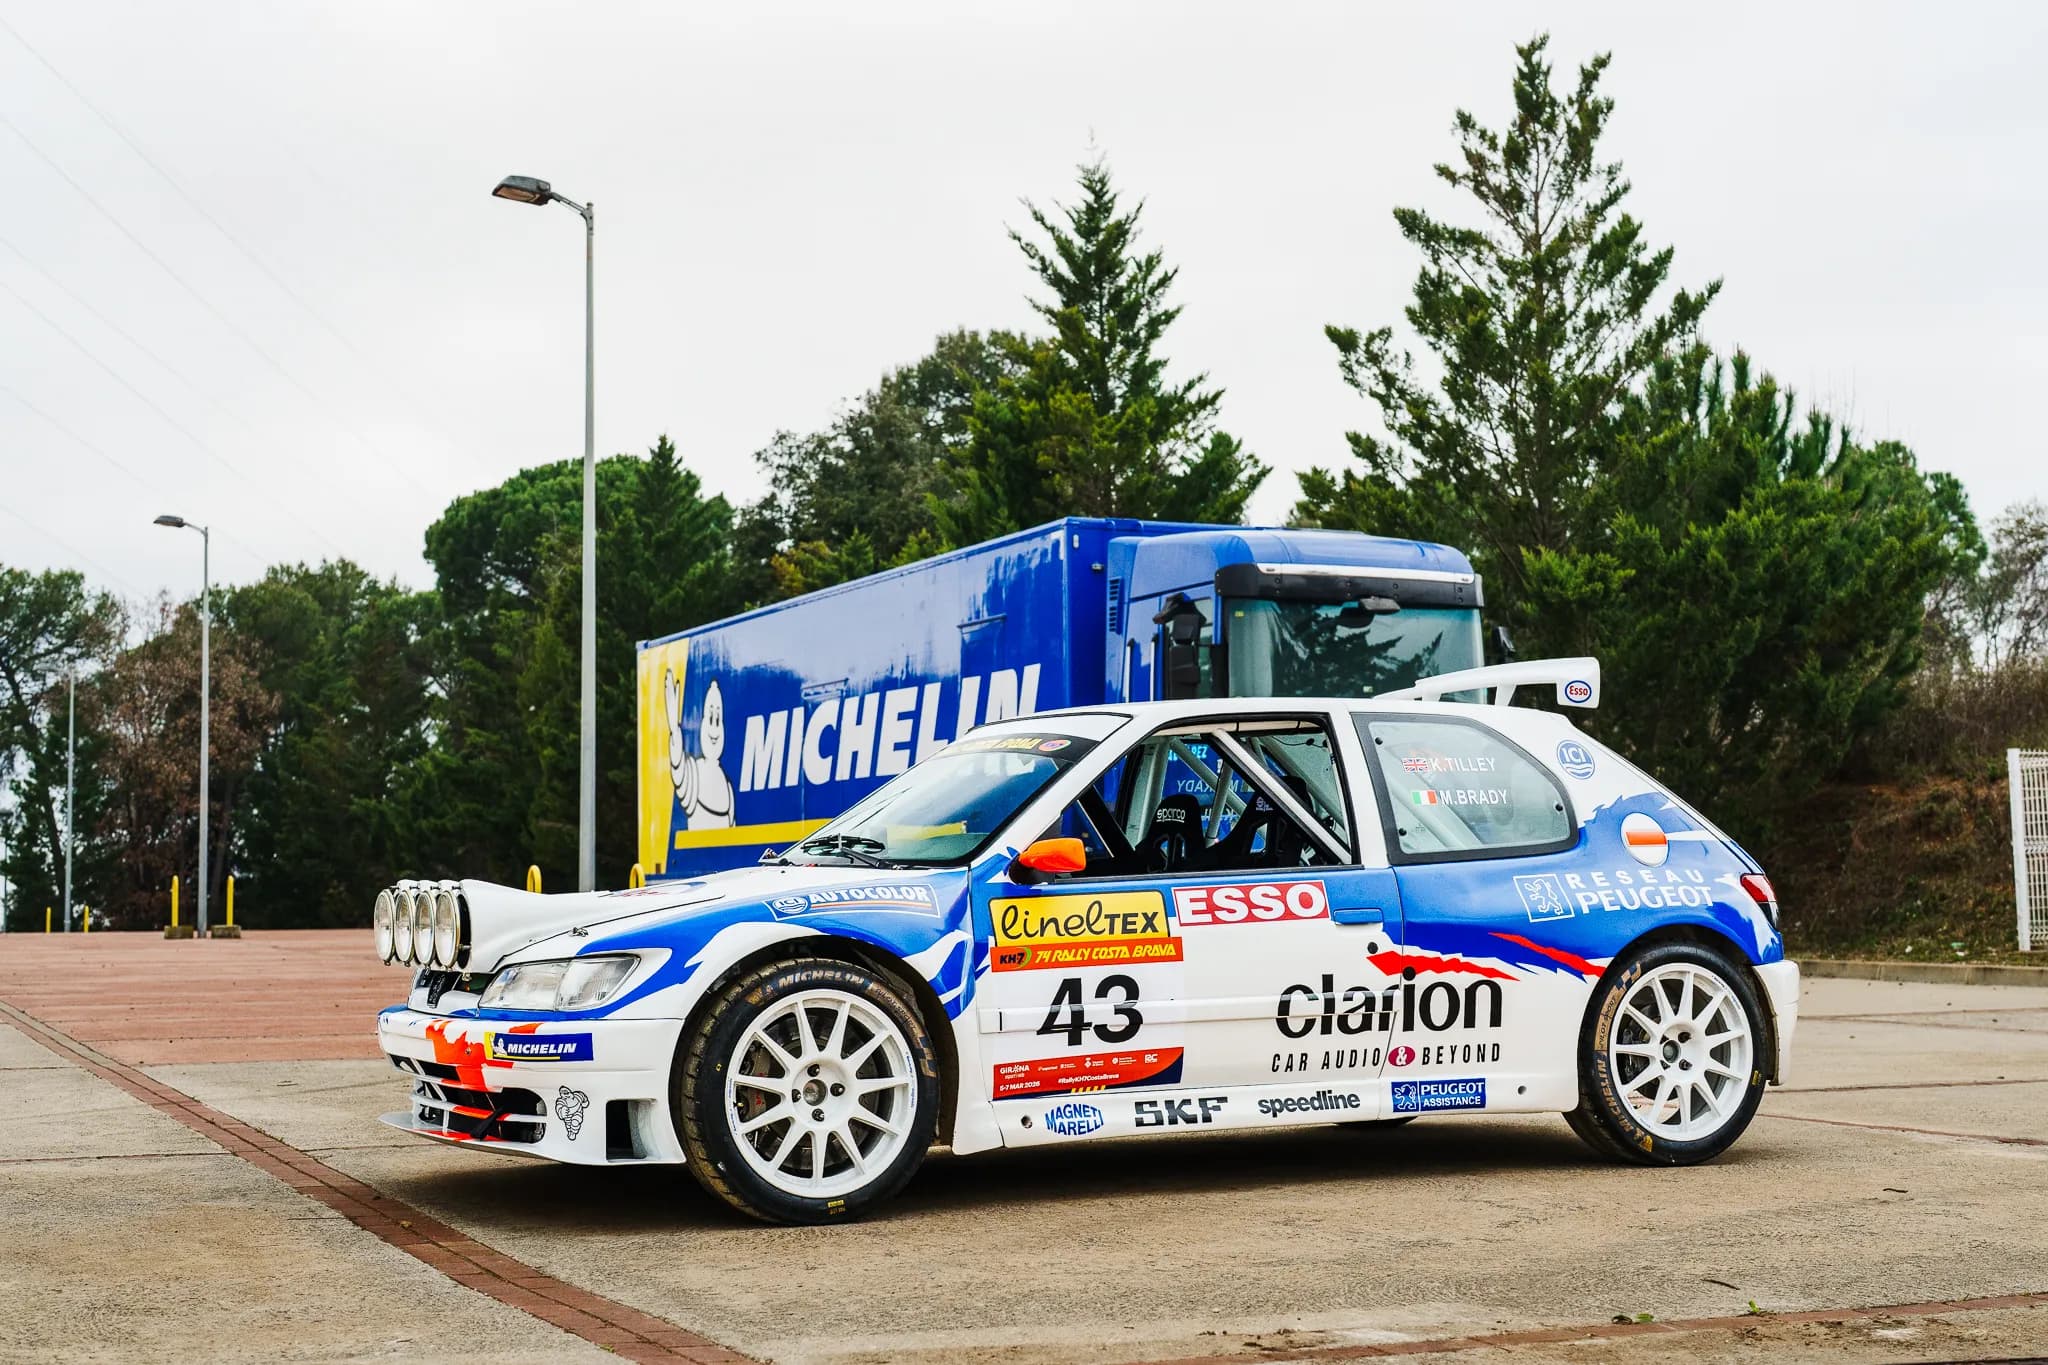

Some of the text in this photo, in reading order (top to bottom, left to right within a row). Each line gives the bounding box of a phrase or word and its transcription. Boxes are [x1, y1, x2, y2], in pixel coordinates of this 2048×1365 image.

[1569, 685, 1588, 696] Esso
[739, 663, 1041, 793] MICHELIN
[1563, 747, 1586, 763] ICI
[1431, 757, 1496, 772] K.TILLEY
[1440, 789, 1508, 805] M.BRADY
[1157, 807, 1186, 822] sparco
[1565, 869, 1705, 889] RESEAU
[811, 886, 932, 904] AUTOCOLOR
[1175, 883, 1326, 924] ESSO
[1576, 886, 1714, 915] PEUGEOT
[1052, 948, 1090, 962] RALLY
[1092, 945, 1130, 960] COSTA
[1132, 943, 1177, 958] BRAVA
[778, 970, 865, 988] MICHELIN
[1036, 974, 1143, 1046] 43
[1275, 966, 1503, 1038] clarion
[507, 1042, 577, 1054] MICHELIN
[1272, 1052, 1308, 1072] CAR
[1321, 1047, 1381, 1069] AUDIO
[1421, 1043, 1501, 1065] BEYOND
[1421, 1081, 1485, 1095] PEUGEOT
[1258, 1090, 1361, 1117] speedline
[1423, 1096, 1481, 1107] ASSISTANCE
[1134, 1096, 1228, 1127] SKF
